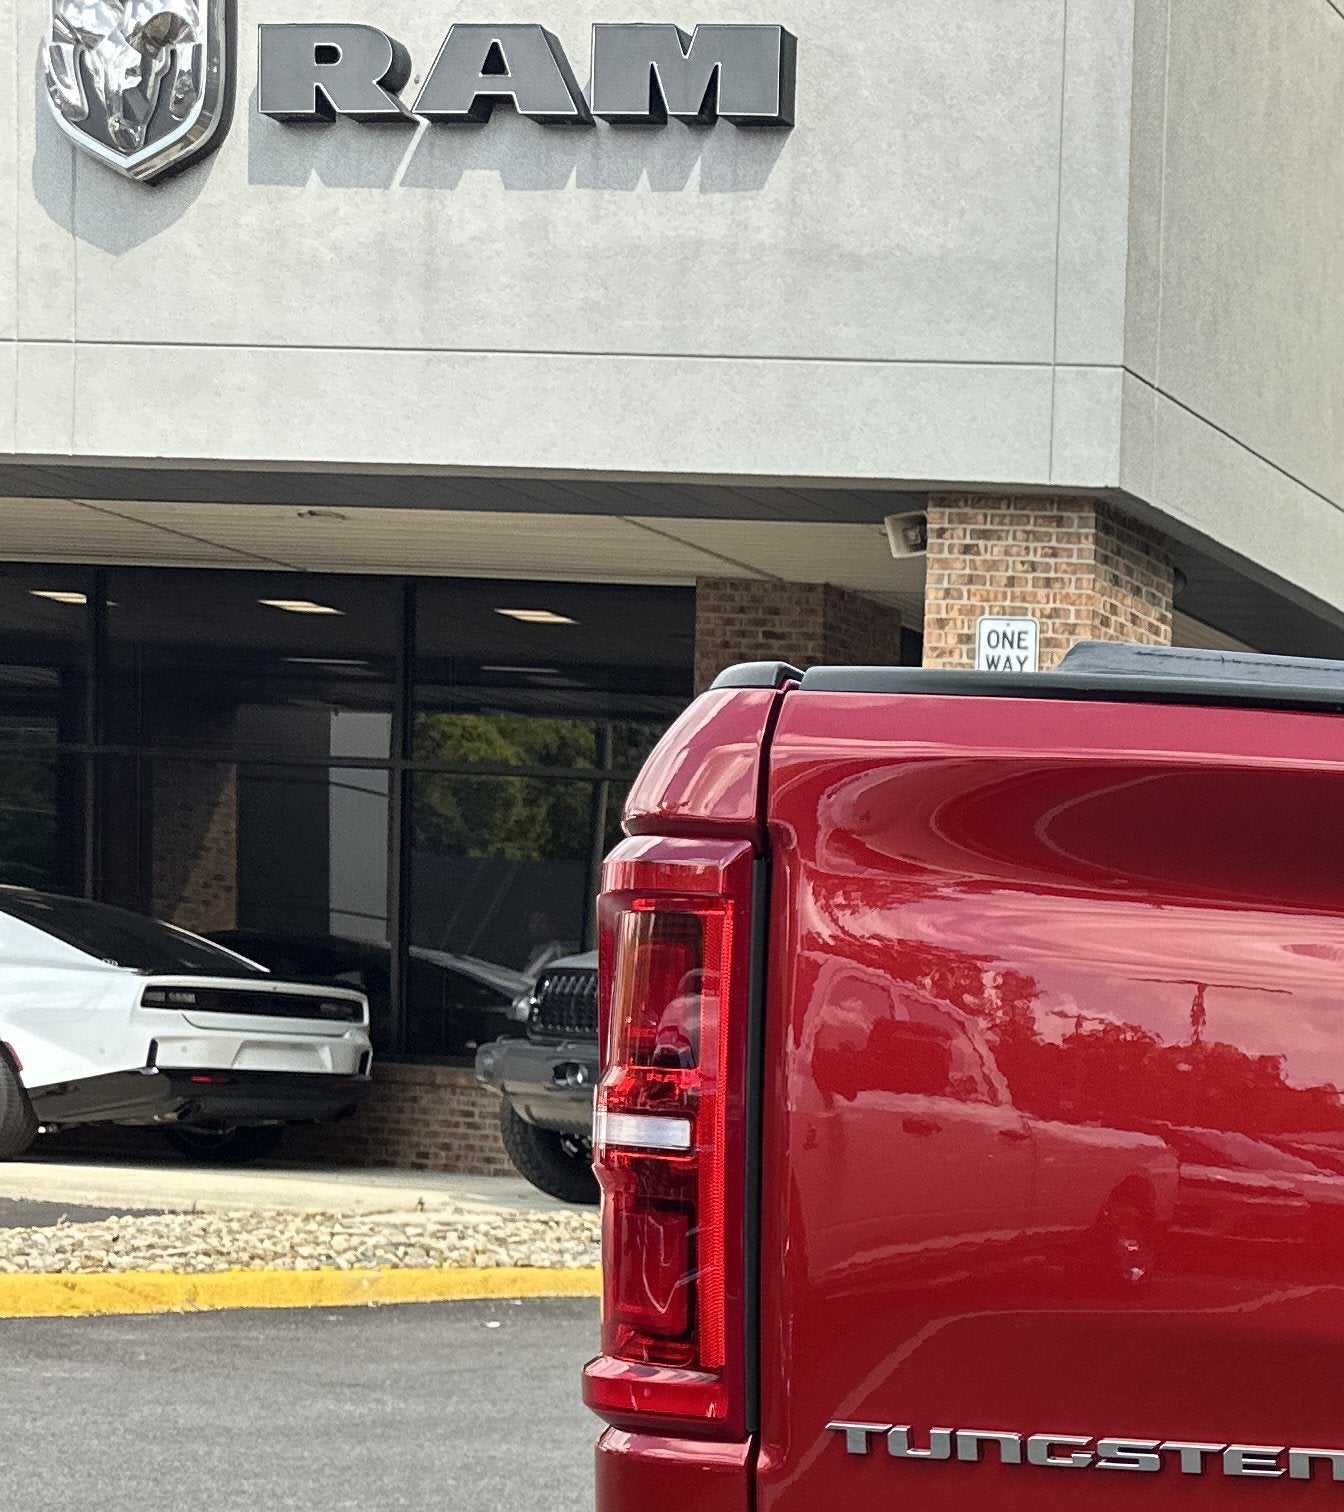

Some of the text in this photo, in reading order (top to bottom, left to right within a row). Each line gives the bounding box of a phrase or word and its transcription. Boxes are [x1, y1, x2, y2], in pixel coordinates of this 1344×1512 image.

[258, 23, 797, 124] RAM
[987, 629, 1028, 650] ONE
[986, 653, 1028, 672] WAY
